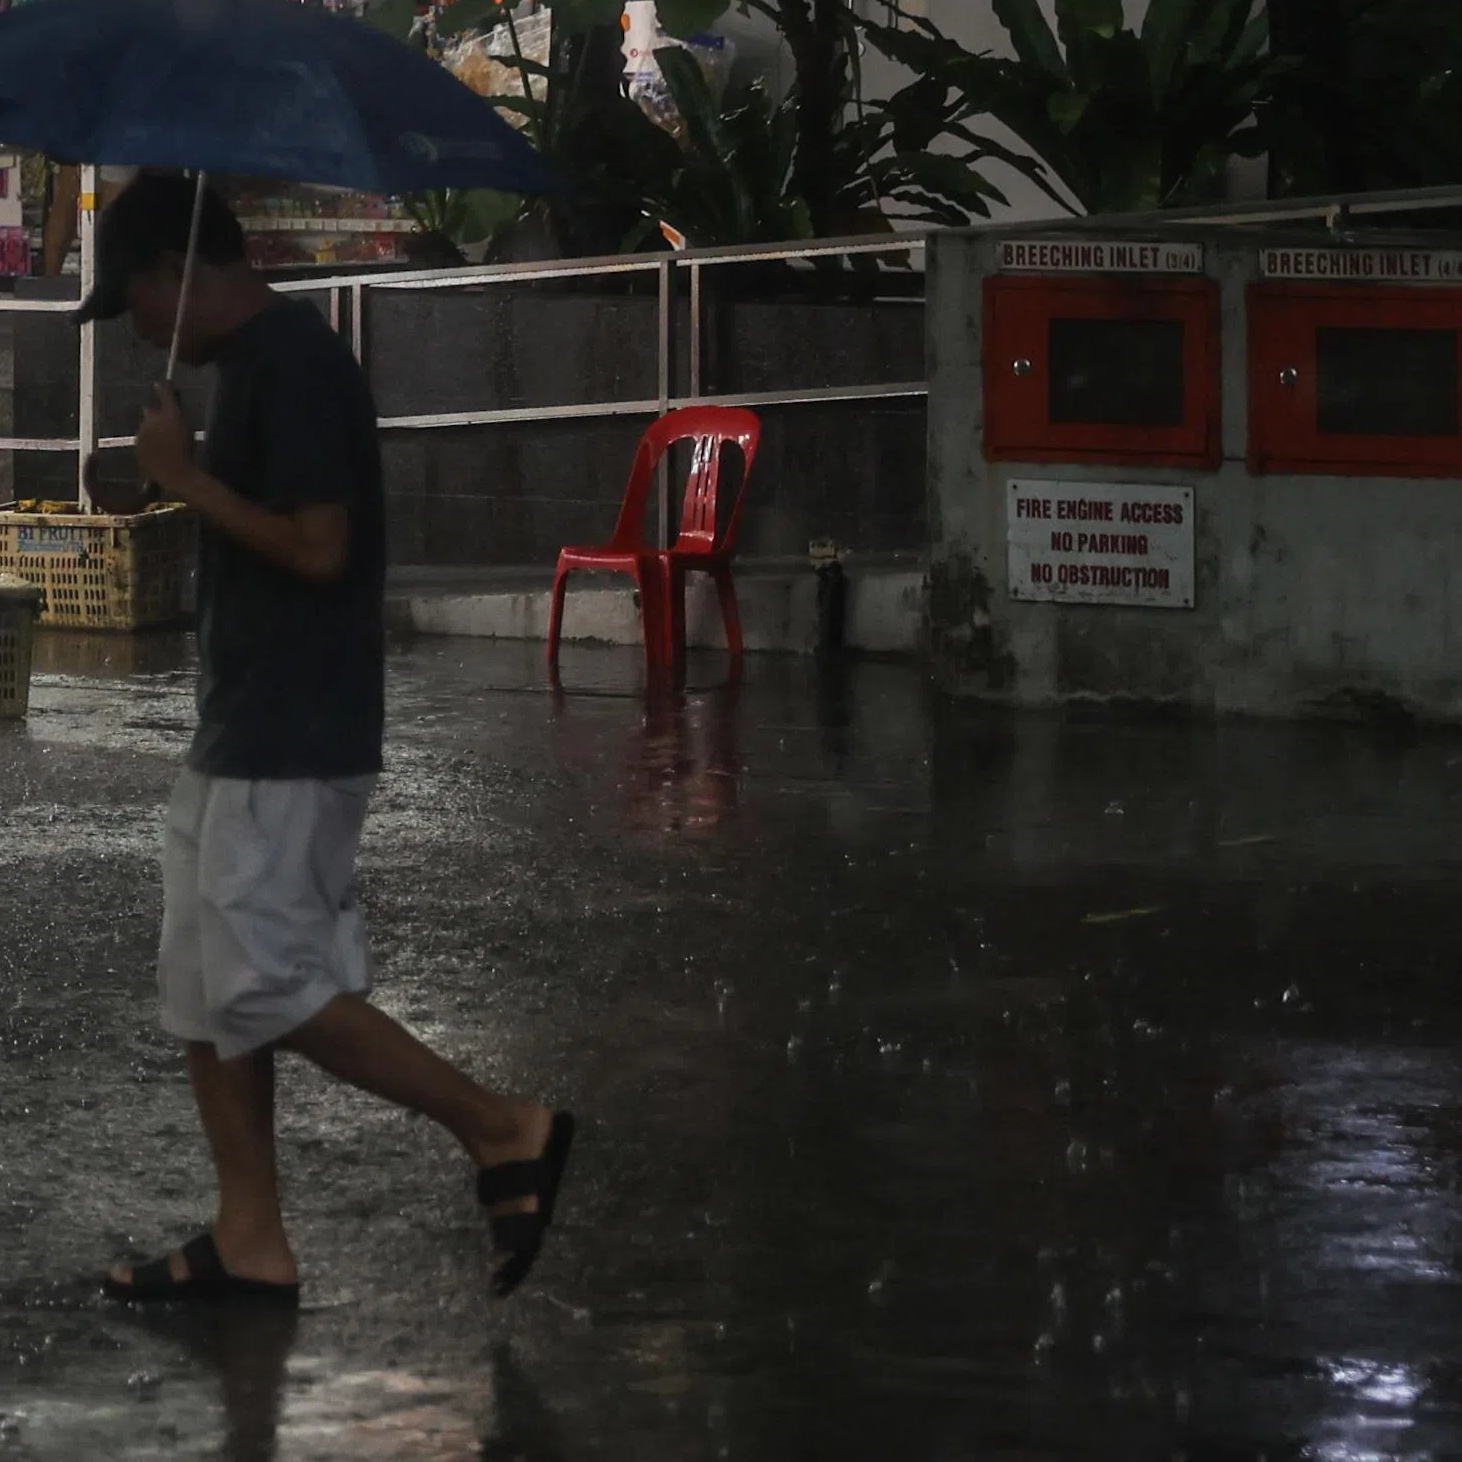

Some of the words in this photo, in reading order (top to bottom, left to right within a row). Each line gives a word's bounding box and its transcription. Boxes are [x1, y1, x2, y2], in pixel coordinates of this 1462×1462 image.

[1003, 243, 1103, 269] BREECHING
[1110, 245, 1160, 269] INLET
[1267, 252, 1374, 276] BREECHING
[1379, 254, 1431, 277] INLET
[1017, 498, 1052, 519] FIRE
[1057, 499, 1113, 521] ENGINE
[1120, 502, 1183, 524] ACCESS
[1051, 531, 1073, 551] NO
[1078, 533, 1148, 555] PARKING
[1031, 563, 1053, 583] NO
[1058, 564, 1170, 589] OBSTRUCTION
